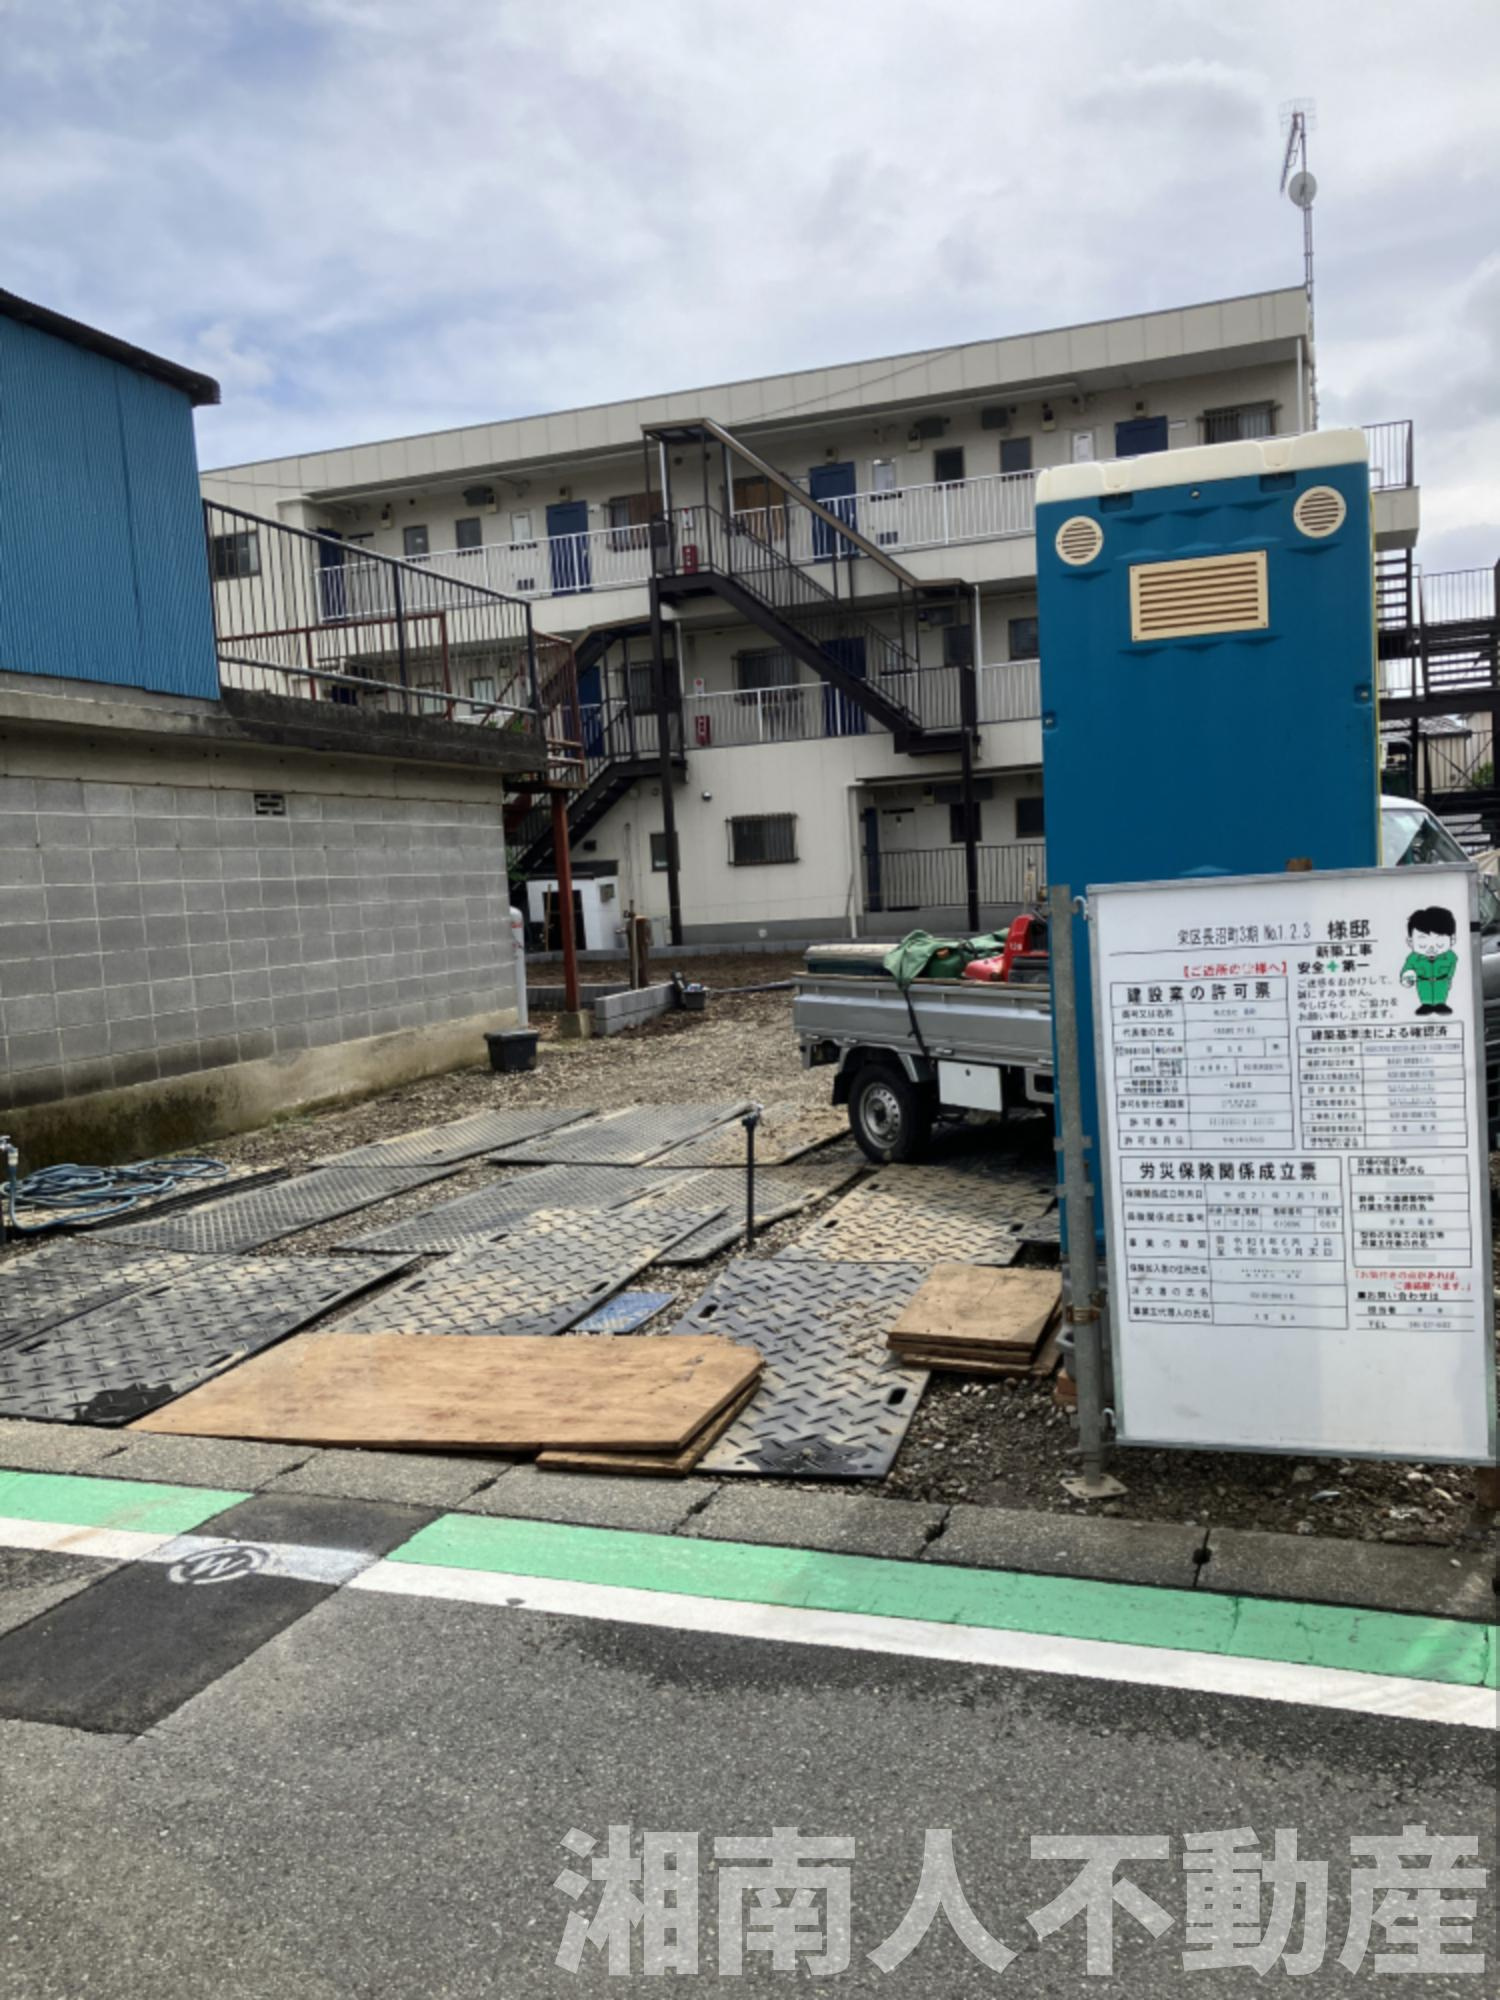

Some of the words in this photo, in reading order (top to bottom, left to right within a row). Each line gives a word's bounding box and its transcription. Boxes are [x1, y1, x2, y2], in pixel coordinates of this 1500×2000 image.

[1178, 924, 1259, 945] 栄区長沼町3期
[1327, 919, 1371, 940] 様邸
[1316, 944, 1372, 958] 新築工事
[1297, 961, 1324, 974] 安全
[1342, 960, 1370, 973] 第一
[1127, 982, 1271, 1003] 建設業の許可票
[1311, 1026, 1448, 1041] 建築基準法による確認済
[1140, 1161, 1317, 1181] 労災保険関係成立票
